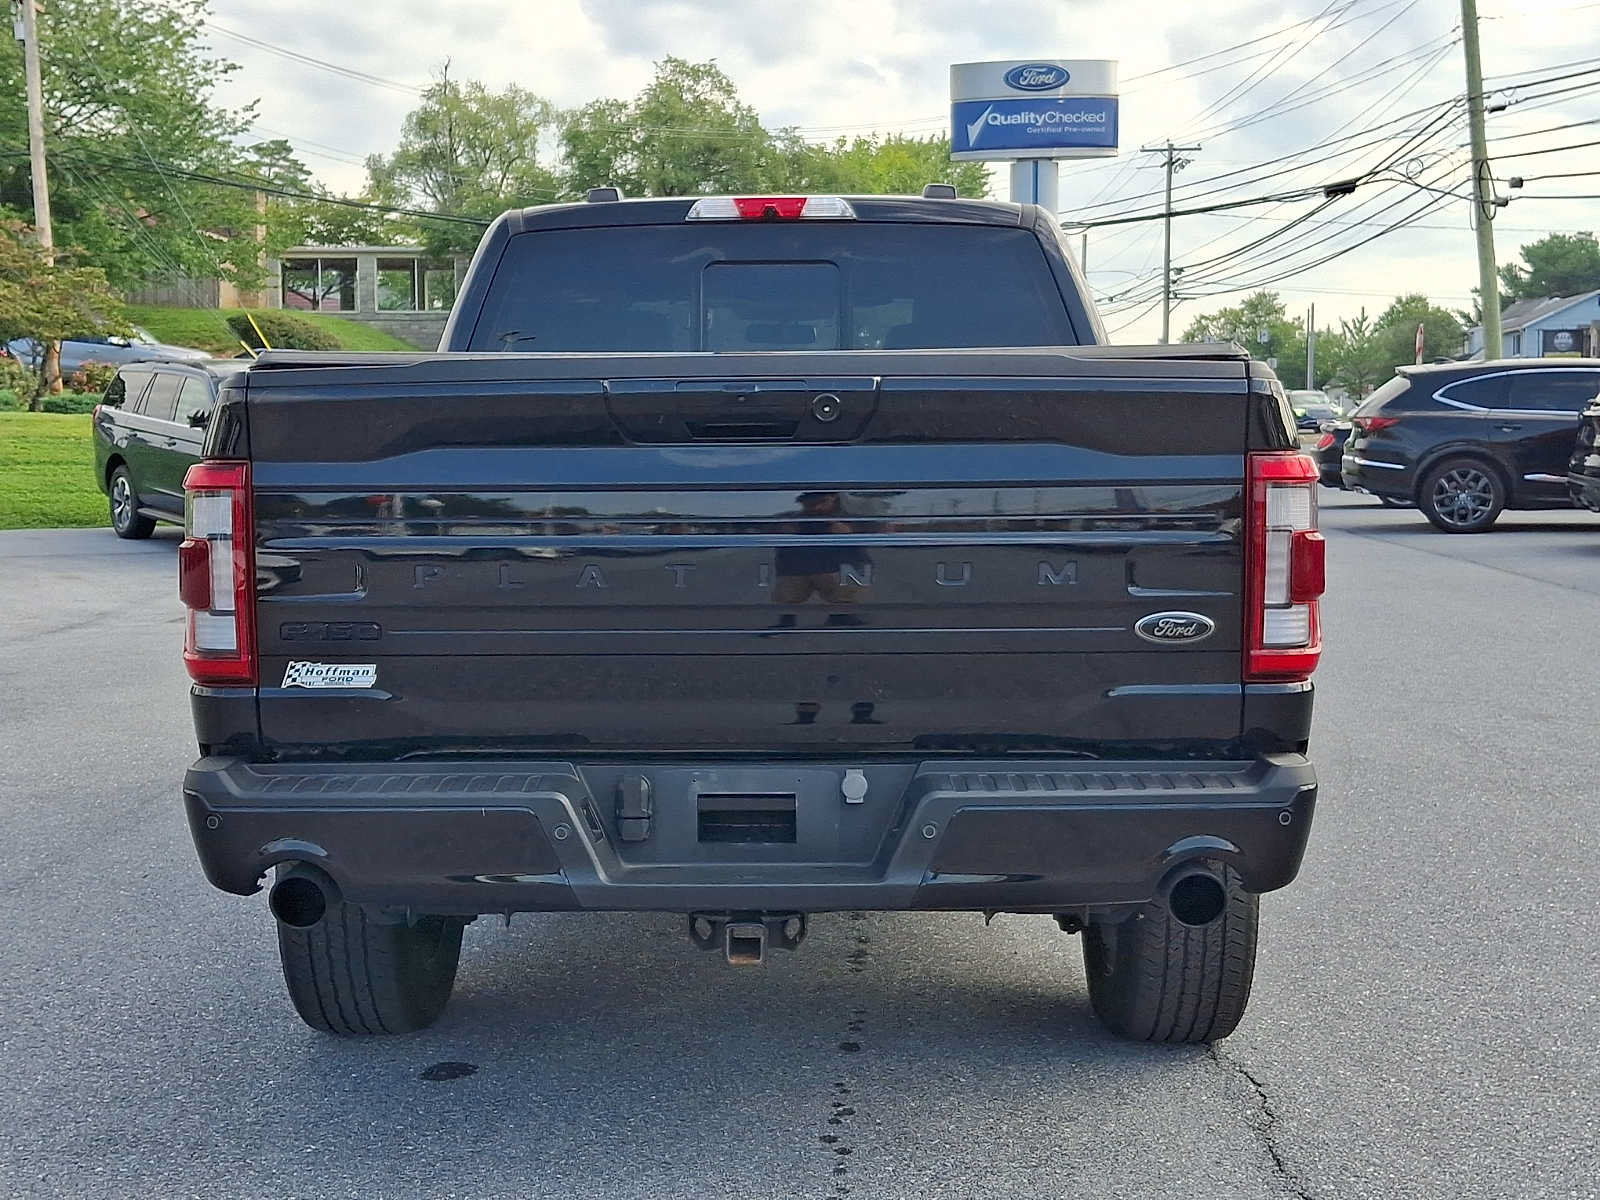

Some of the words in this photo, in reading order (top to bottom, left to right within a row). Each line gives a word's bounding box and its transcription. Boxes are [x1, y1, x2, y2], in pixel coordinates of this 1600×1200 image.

[1019, 68, 1056, 85] Ford
[412, 559, 1079, 589] PLATINUM
[1154, 618, 1197, 636] Ford
[304, 667, 370, 676] Hoffman
